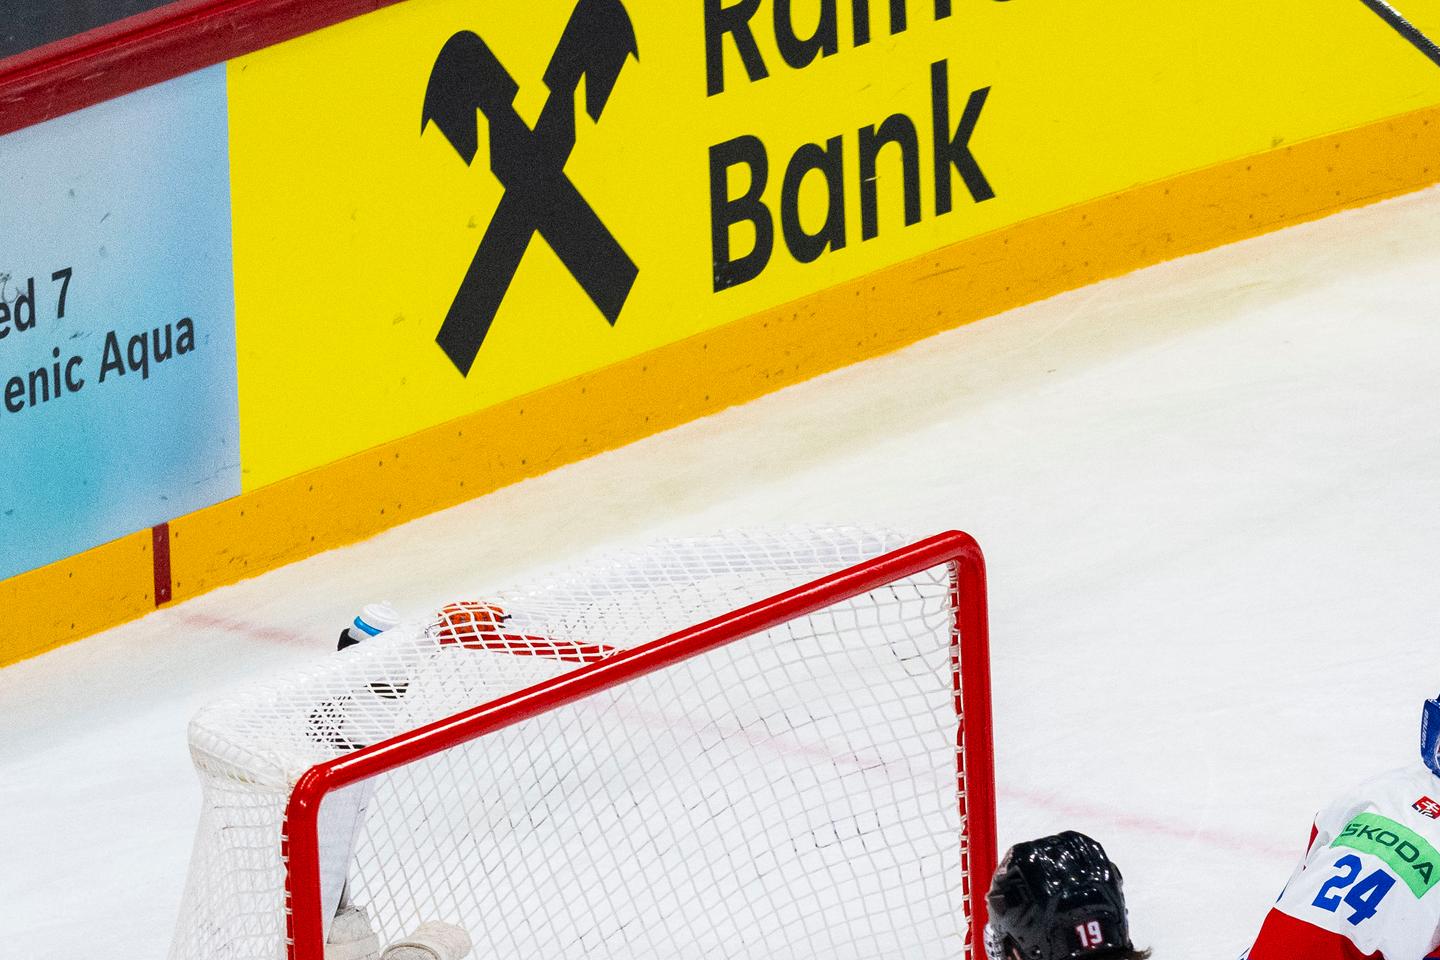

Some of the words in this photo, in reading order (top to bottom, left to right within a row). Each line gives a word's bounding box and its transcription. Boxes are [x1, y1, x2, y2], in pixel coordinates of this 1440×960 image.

[708, 58, 996, 294] Bank
[51, 266, 73, 319] 7
[4, 346, 85, 413] enic
[98, 316, 196, 384] Aqua
[1311, 853, 1397, 926] 24
[1075, 920, 1103, 948] 19
